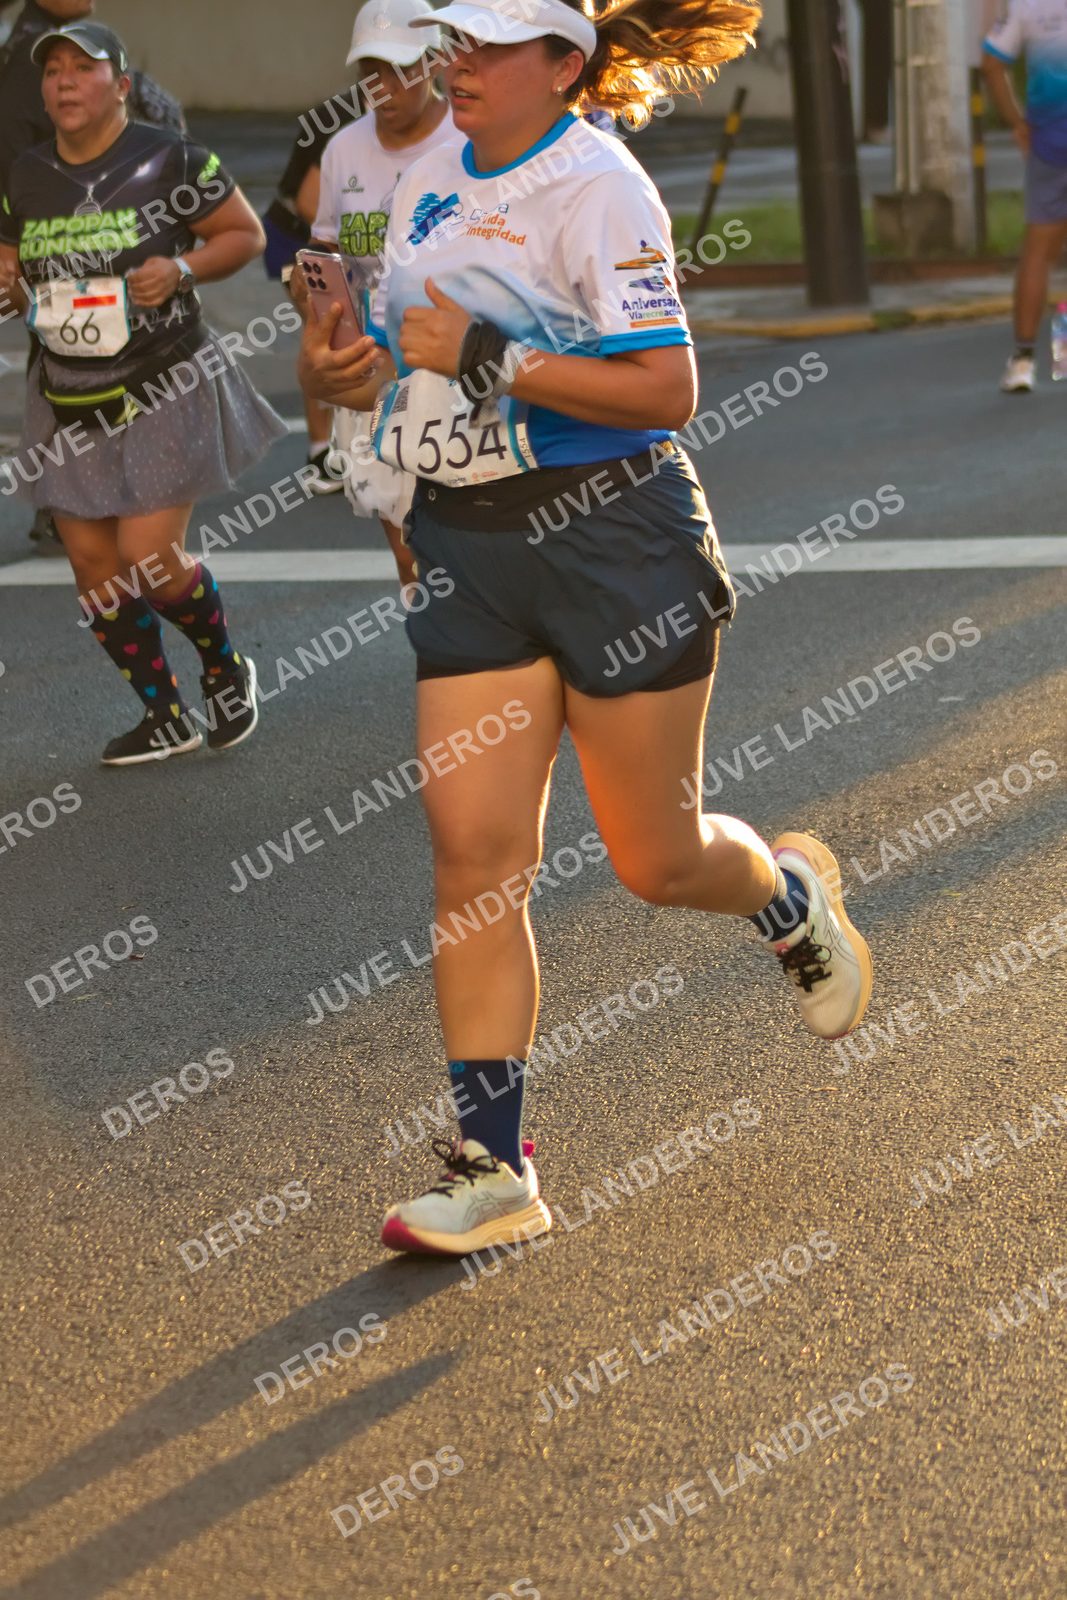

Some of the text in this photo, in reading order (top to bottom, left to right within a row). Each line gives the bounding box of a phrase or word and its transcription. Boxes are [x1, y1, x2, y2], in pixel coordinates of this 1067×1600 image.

[22, 208, 138, 240] ZAPOPAN
[60, 312, 100, 345] 66
[391, 413, 507, 474] 1554
[520, 437, 532, 459] 1554
